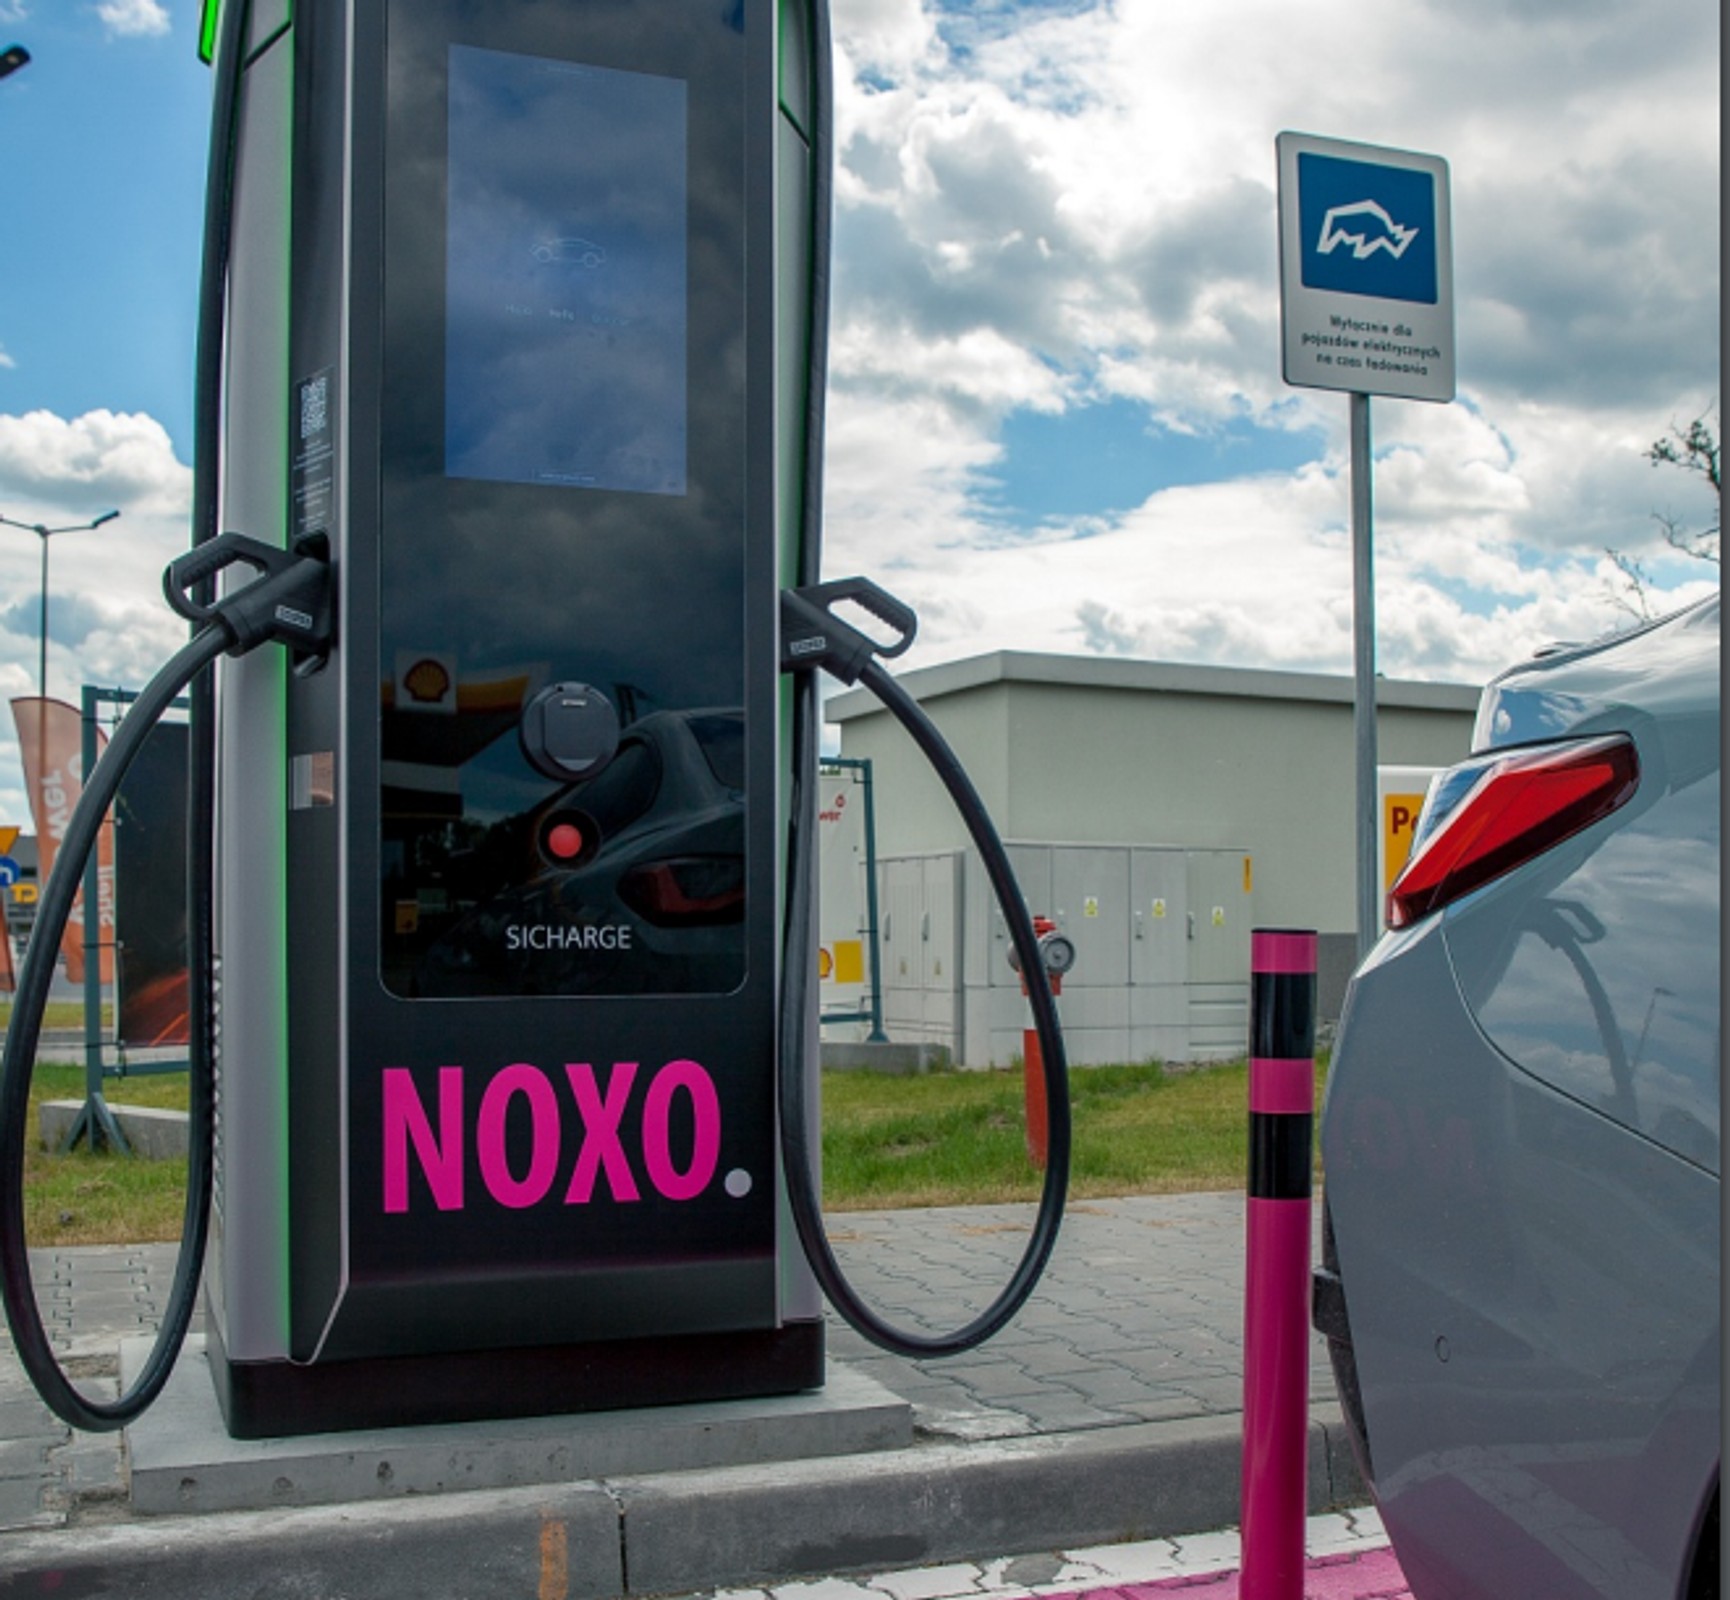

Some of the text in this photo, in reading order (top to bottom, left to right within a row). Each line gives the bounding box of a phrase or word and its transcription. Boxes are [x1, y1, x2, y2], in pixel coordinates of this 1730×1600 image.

[1393, 324, 1412, 337] dla
[1302, 332, 1440, 360] pojazdów elektrycznych
[1316, 353, 1332, 365] na
[1336, 356, 1362, 368] czas
[506, 924, 632, 949] SICHARGE
